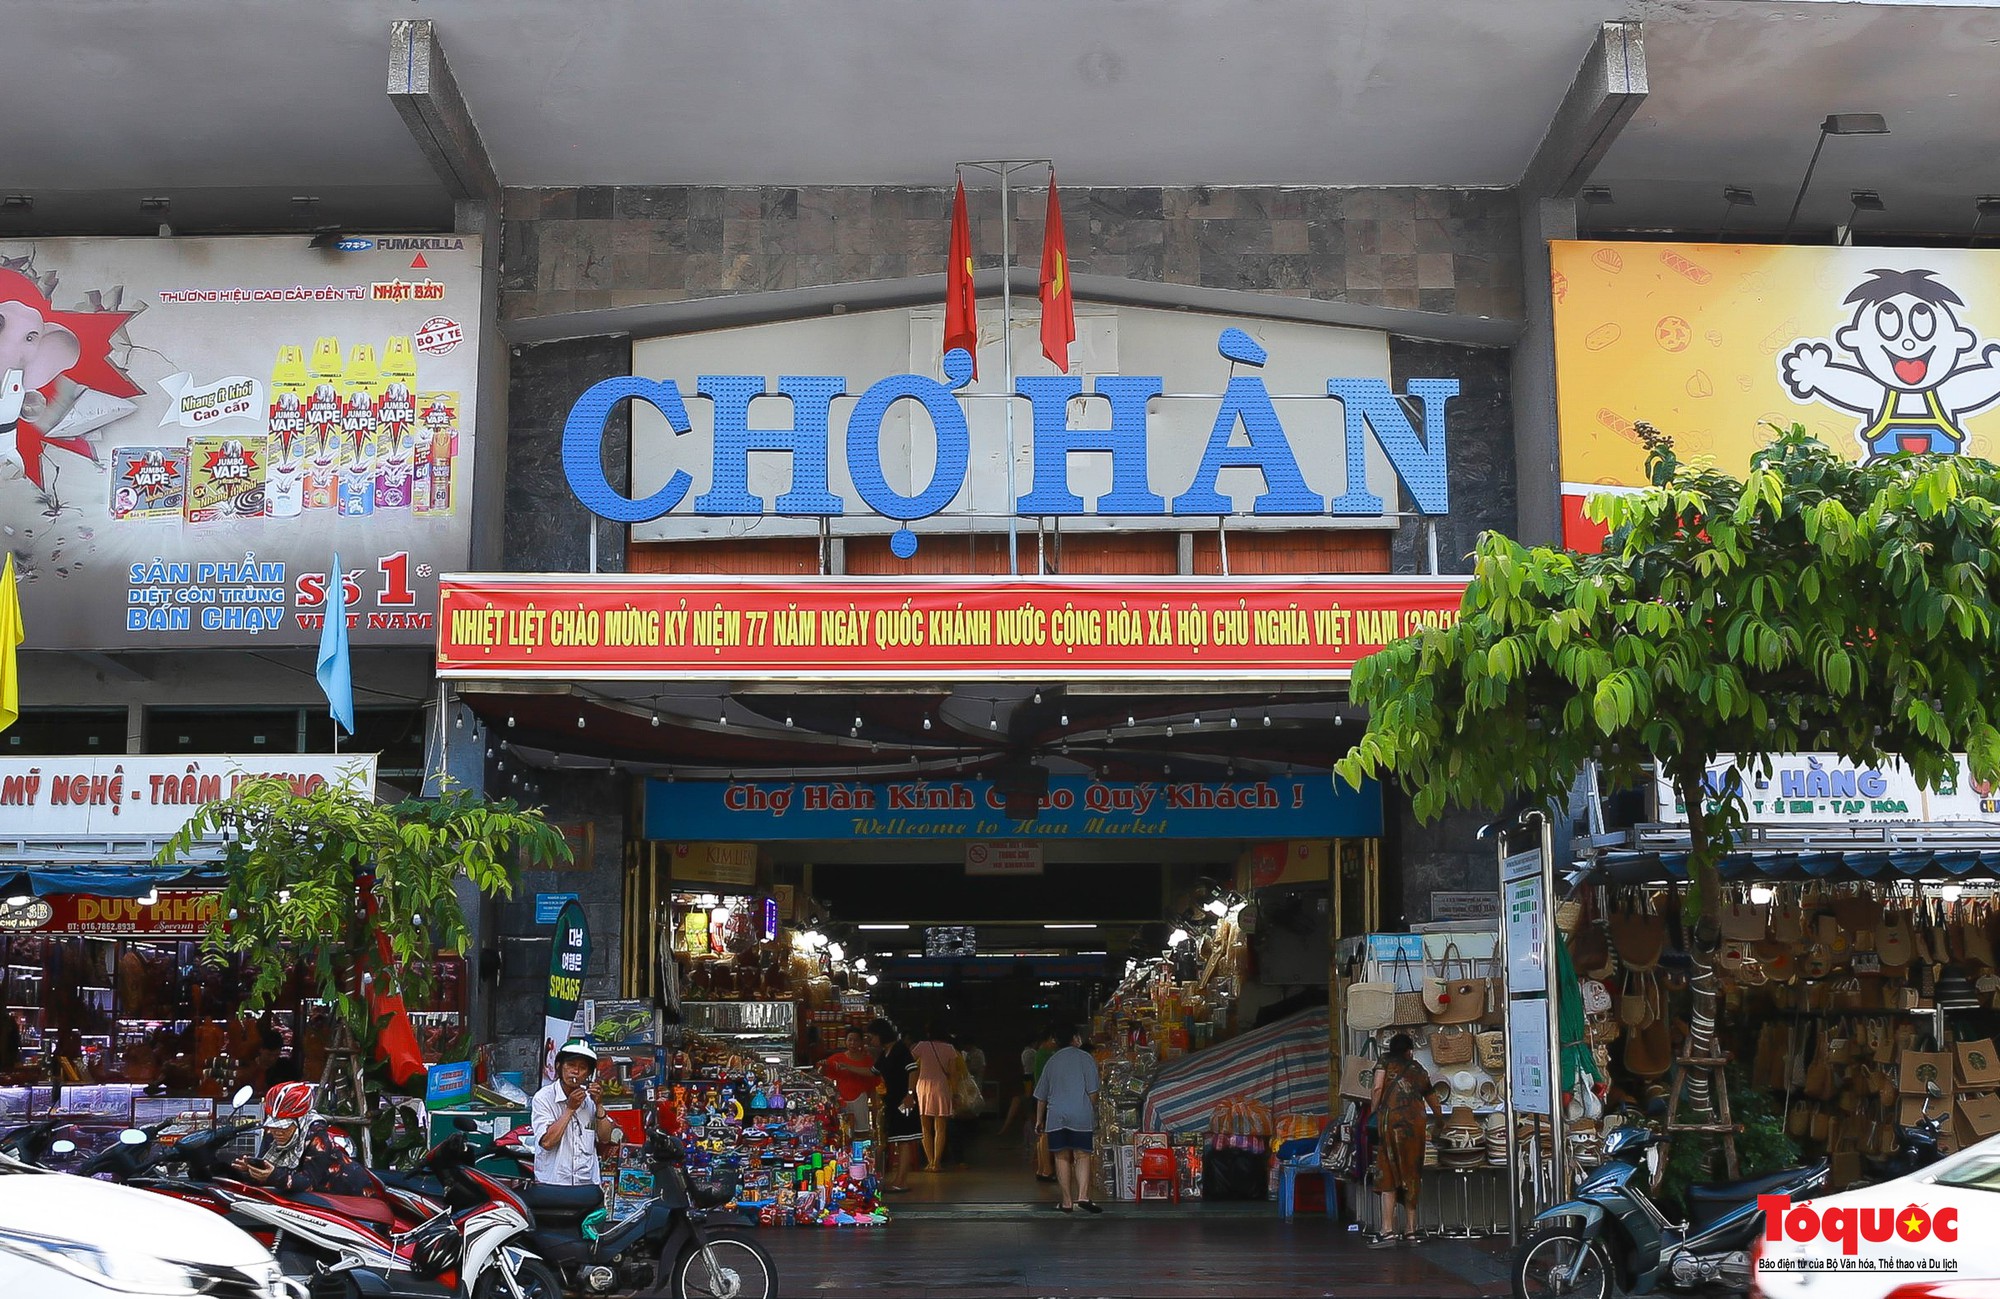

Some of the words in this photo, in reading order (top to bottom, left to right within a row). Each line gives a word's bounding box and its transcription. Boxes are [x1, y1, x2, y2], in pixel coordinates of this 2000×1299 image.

[376, 238, 464, 250] FUMAKILLA
[160, 290, 217, 302] THƯƠNG
[220, 288, 251, 304] HIỆU
[254, 290, 282, 301] CAO
[346, 286, 366, 300] TỪ
[372, 281, 411, 303] NHẬT
[413, 279, 445, 300] BẢN
[182, 393, 215, 412] Nhang
[217, 388, 228, 403] ít
[228, 381, 253, 400] khói
[193, 408, 220, 422] Cao
[226, 400, 250, 418] cấp
[274, 411, 300, 419] JUMBO
[311, 403, 336, 411] JUMBO
[383, 402, 409, 410] JUMBO
[306, 410, 341, 423] VAPE
[342, 418, 377, 431] VAPE
[379, 409, 414, 422] VAPE
[425, 416, 449, 424] VAPE
[270, 419, 305, 431] VAPE
[561, 347, 973, 560] CHỢ
[1014, 327, 1461, 517] HÀN
[139, 466, 165, 474] JUMBO
[217, 458, 244, 466] JUMBO
[134, 473, 170, 485] VAPE
[212, 465, 248, 479] VAPE
[436, 492, 446, 500] 60
[130, 557, 190, 584] SẢN
[197, 551, 286, 584] PHẨM
[377, 551, 415, 607] 1
[128, 587, 173, 604] DIỆT
[175, 586, 216, 603] CÔN
[219, 585, 285, 603] TRÙNG
[127, 603, 190, 631] BÁN
[201, 607, 285, 635] CHẠY
[367, 613, 433, 630] NAM
[451, 602, 504, 654] NHIỆT
[509, 602, 545, 654] LIỆT
[550, 602, 599, 646] CHÀO
[604, 602, 660, 646] MỪNG
[664, 598, 689, 646] KỶ
[693, 602, 741, 654] NIỆM
[745, 610, 769, 646] 77
[773, 603, 815, 646] NĂM
[821, 603, 870, 646] NGÀY
[875, 598, 924, 650] QUỐC
[929, 603, 991, 646] KHÁNH
[996, 602, 1046, 646] NƯỚC
[1051, 603, 1102, 654] CỘNG
[1106, 602, 1143, 646] HÒA
[1148, 603, 1173, 646] XÃ
[1177, 603, 1207, 654] HỘI
[1212, 598, 1248, 647] CHỦ
[1254, 603, 1310, 646] NGHĨA
[1313, 603, 1352, 654] VIỆT
[1356, 610, 1398, 646] NAM
[1781, 756, 1888, 799] HẰNG
[1, 768, 41, 806] MỸ
[51, 765, 124, 816] NGHỆ
[131, 790, 141, 800] -
[149, 761, 222, 805] TRẦM
[724, 784, 792, 817] Chợ
[803, 782, 876, 810] Hàn
[887, 783, 976, 810] Kính
[1085, 782, 1157, 816] Quý
[1166, 783, 1279, 810] Khách
[1291, 783, 1304, 809] !
[1789, 800, 1814, 814] EM
[1830, 800, 1865, 815] TẠP
[1871, 797, 1909, 814] HÓA
[851, 818, 967, 835] Wellcome
[976, 820, 998, 834] to
[1076, 816, 1168, 835] Market
[78, 898, 143, 921] DUY
[550, 975, 581, 1002] SPA365
